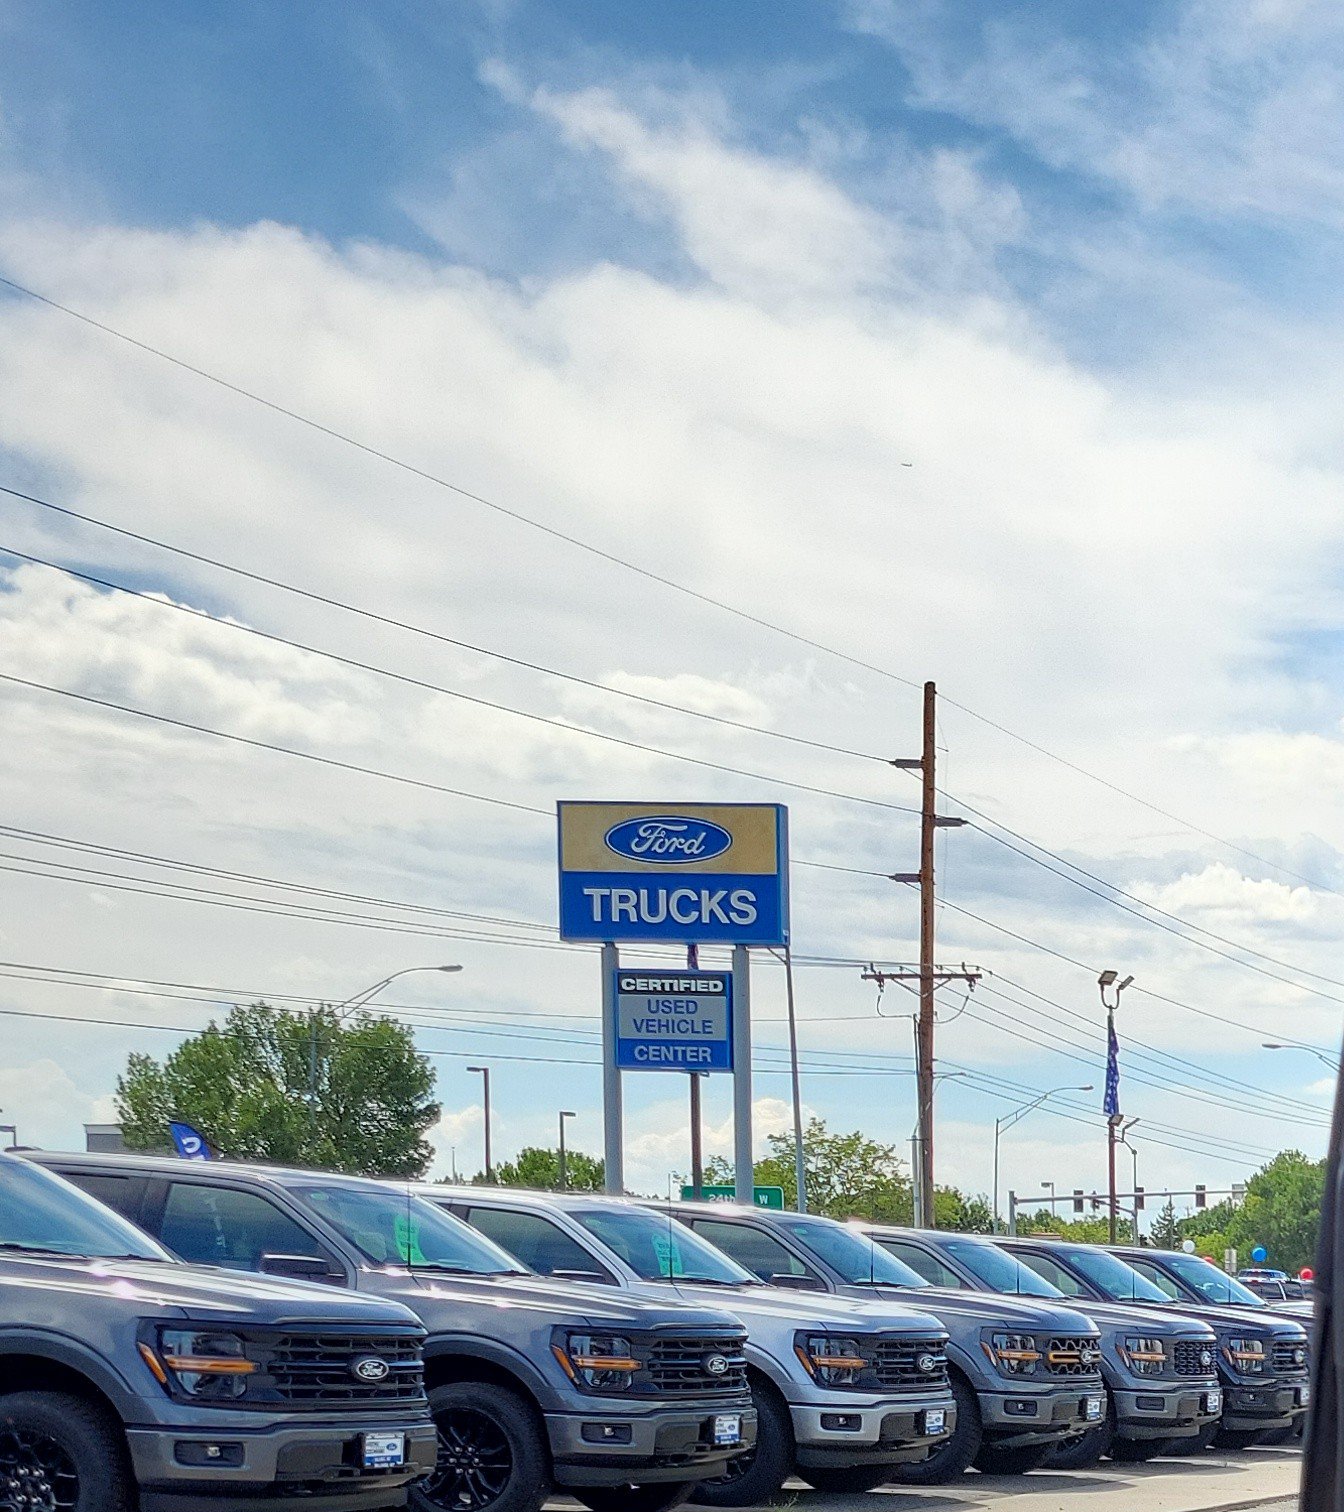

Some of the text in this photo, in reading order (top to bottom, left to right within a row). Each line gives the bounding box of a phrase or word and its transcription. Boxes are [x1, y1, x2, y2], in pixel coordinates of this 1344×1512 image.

[631, 822, 706, 855] Ford
[583, 887, 758, 925] TRUCKS
[620, 978, 724, 993] CERTIFIED
[647, 999, 698, 1015] USED
[633, 1017, 713, 1035] VEHICLE
[633, 1045, 712, 1063] CENTER
[758, 1194, 769, 1205] W
